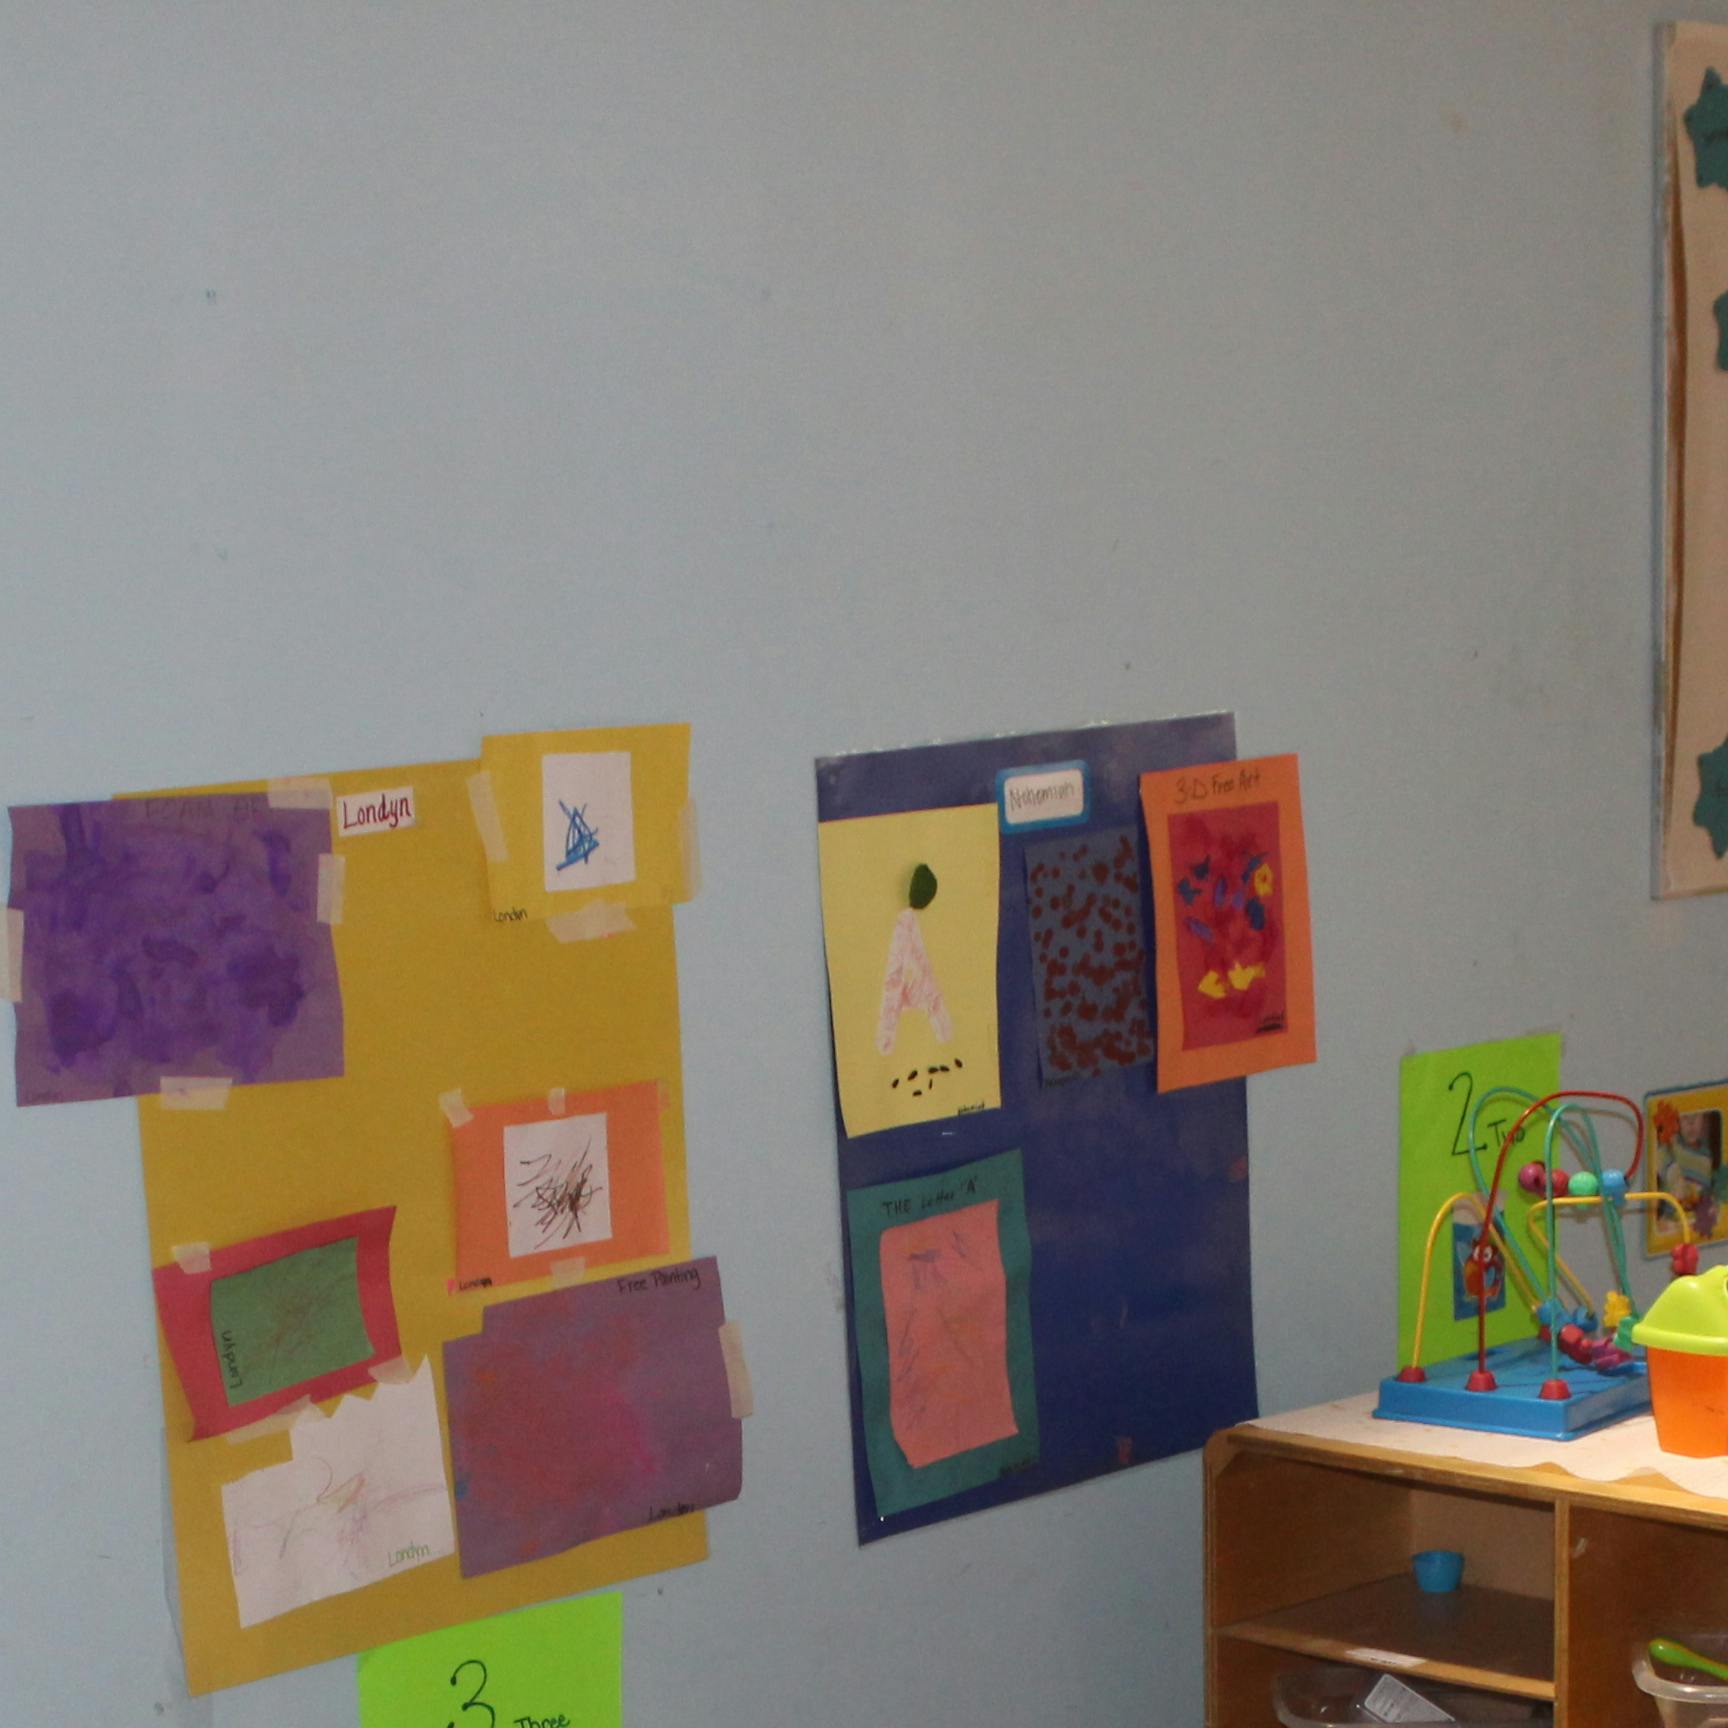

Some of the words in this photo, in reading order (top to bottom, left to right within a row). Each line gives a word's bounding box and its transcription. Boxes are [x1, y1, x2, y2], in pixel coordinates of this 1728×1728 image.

[343, 794, 412, 829] Londyn
[1449, 1072, 1488, 1155] 2
[617, 1278, 647, 1294] Free
